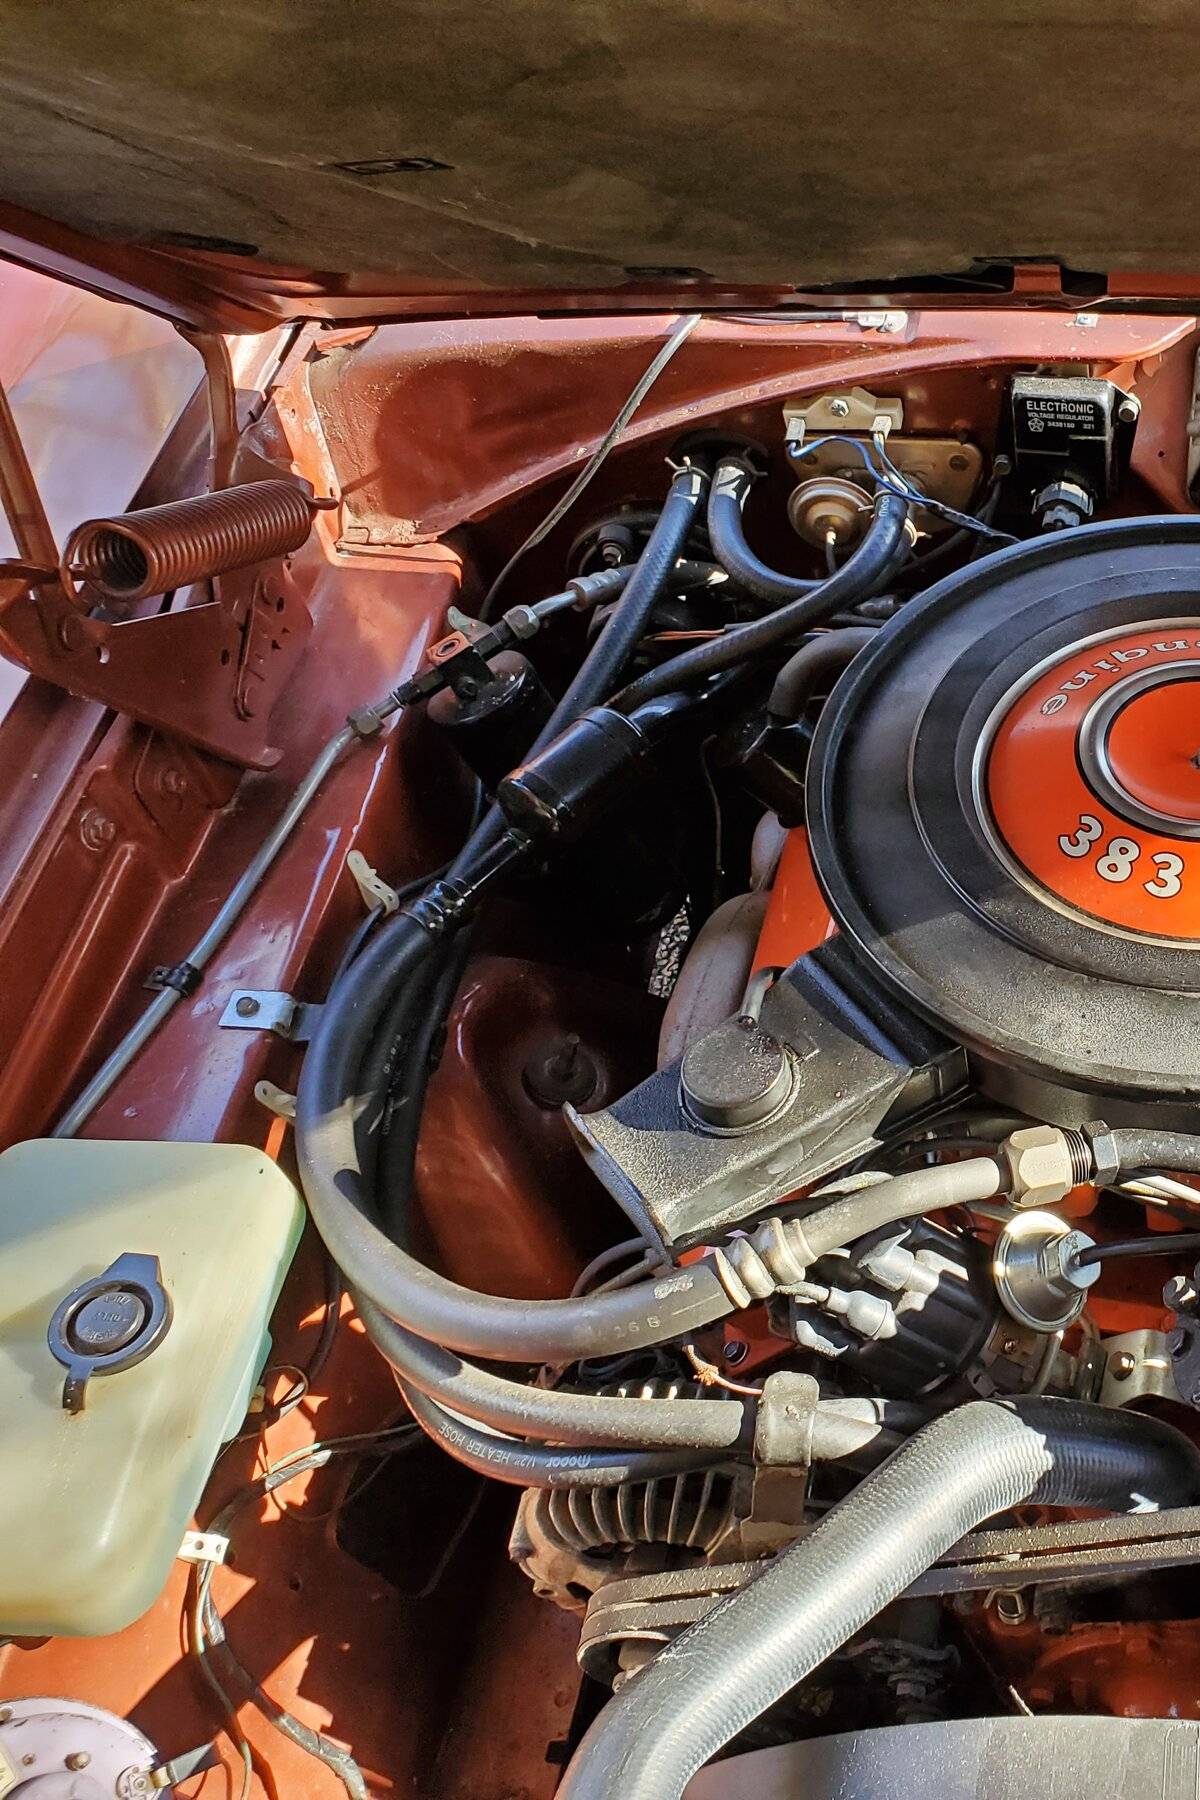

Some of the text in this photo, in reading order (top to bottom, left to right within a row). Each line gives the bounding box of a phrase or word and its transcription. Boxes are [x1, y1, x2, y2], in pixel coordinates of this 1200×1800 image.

[1026, 400, 1094, 414] ELECTRONIC
[1057, 414, 1094, 422] REGULATOR
[1057, 813, 1184, 900] 383
[438, 1421, 467, 1448] HOSE
[469, 1439, 511, 1465] HEATER
[546, 1453, 592, 1470] mopar
